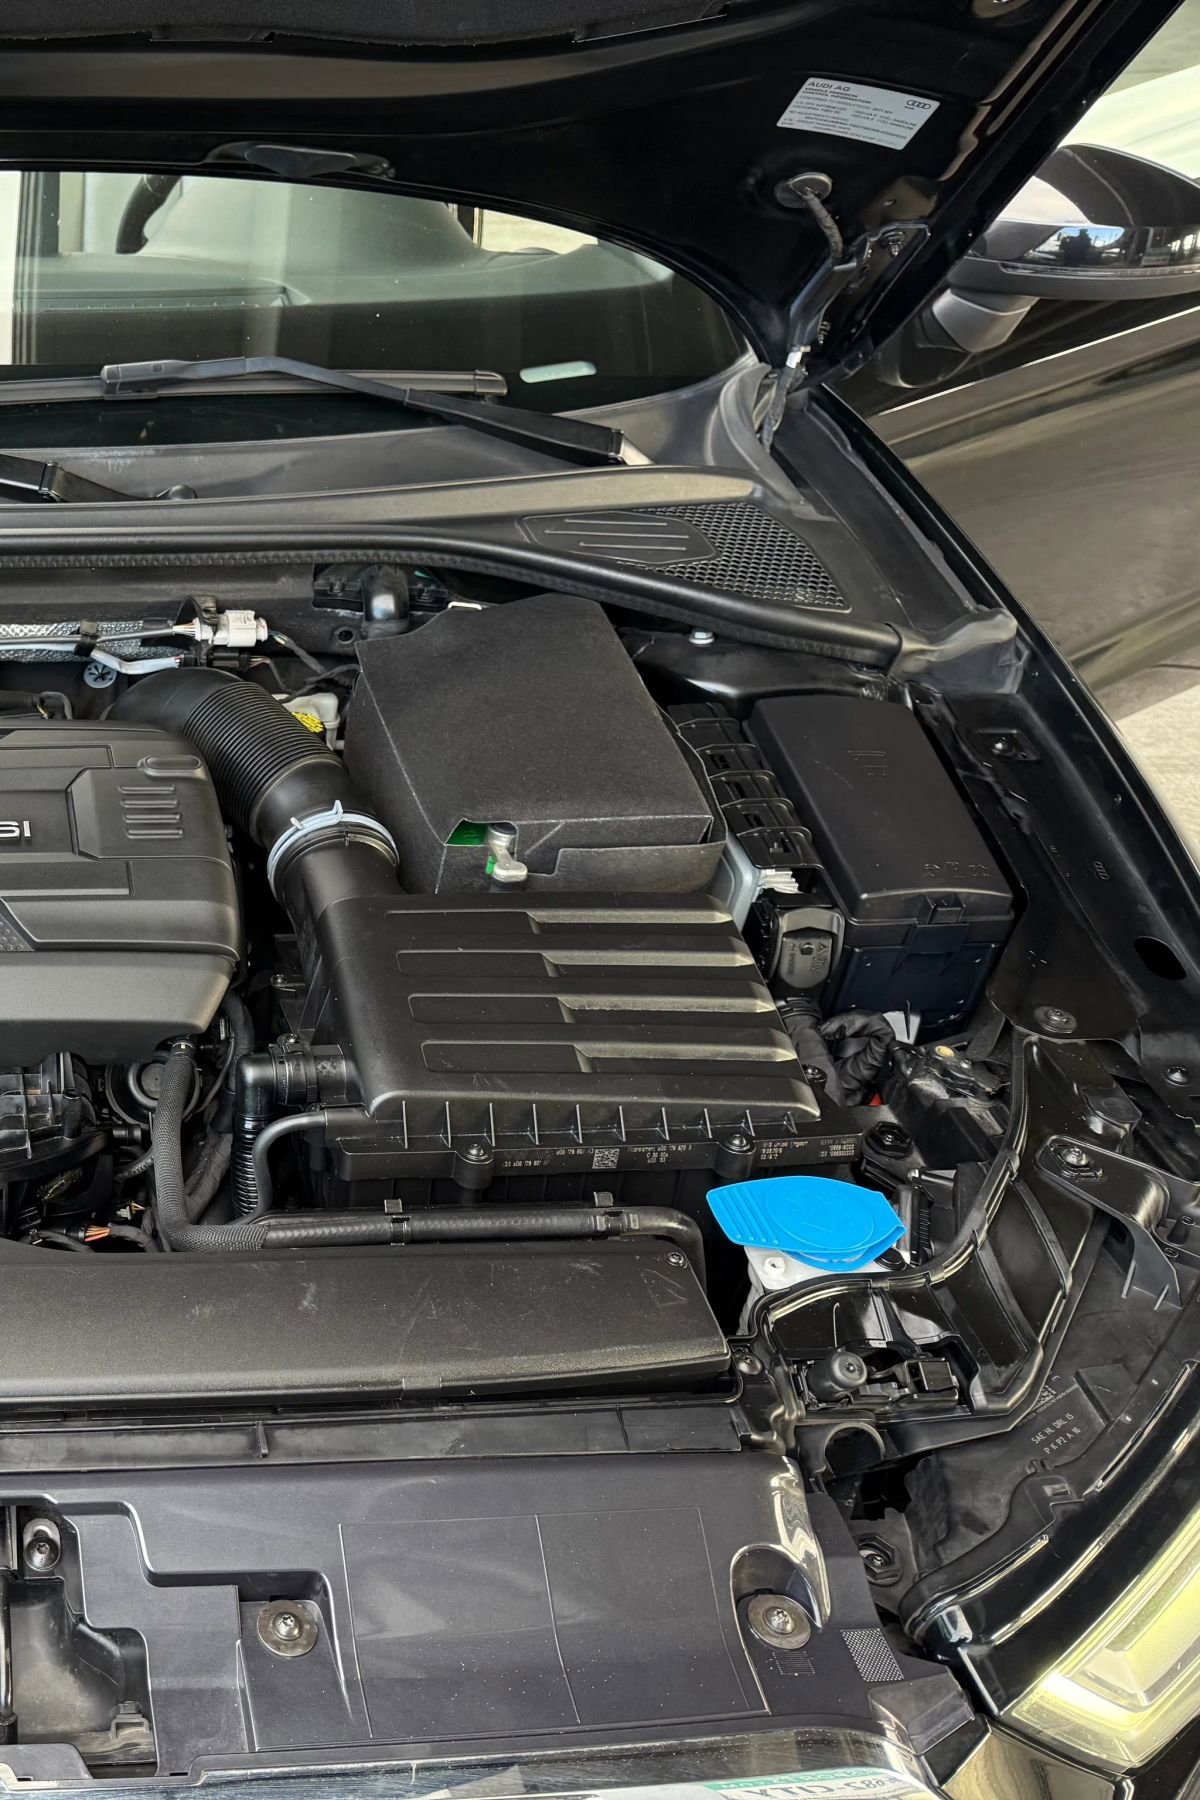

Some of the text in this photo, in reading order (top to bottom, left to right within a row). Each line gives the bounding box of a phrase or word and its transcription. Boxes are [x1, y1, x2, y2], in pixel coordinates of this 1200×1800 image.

[808, 81, 834, 89] AUDI
[1031, 1431, 1046, 1444] SAE
[1044, 1426, 1055, 1435] HL
[1052, 1418, 1067, 1429] DRL
